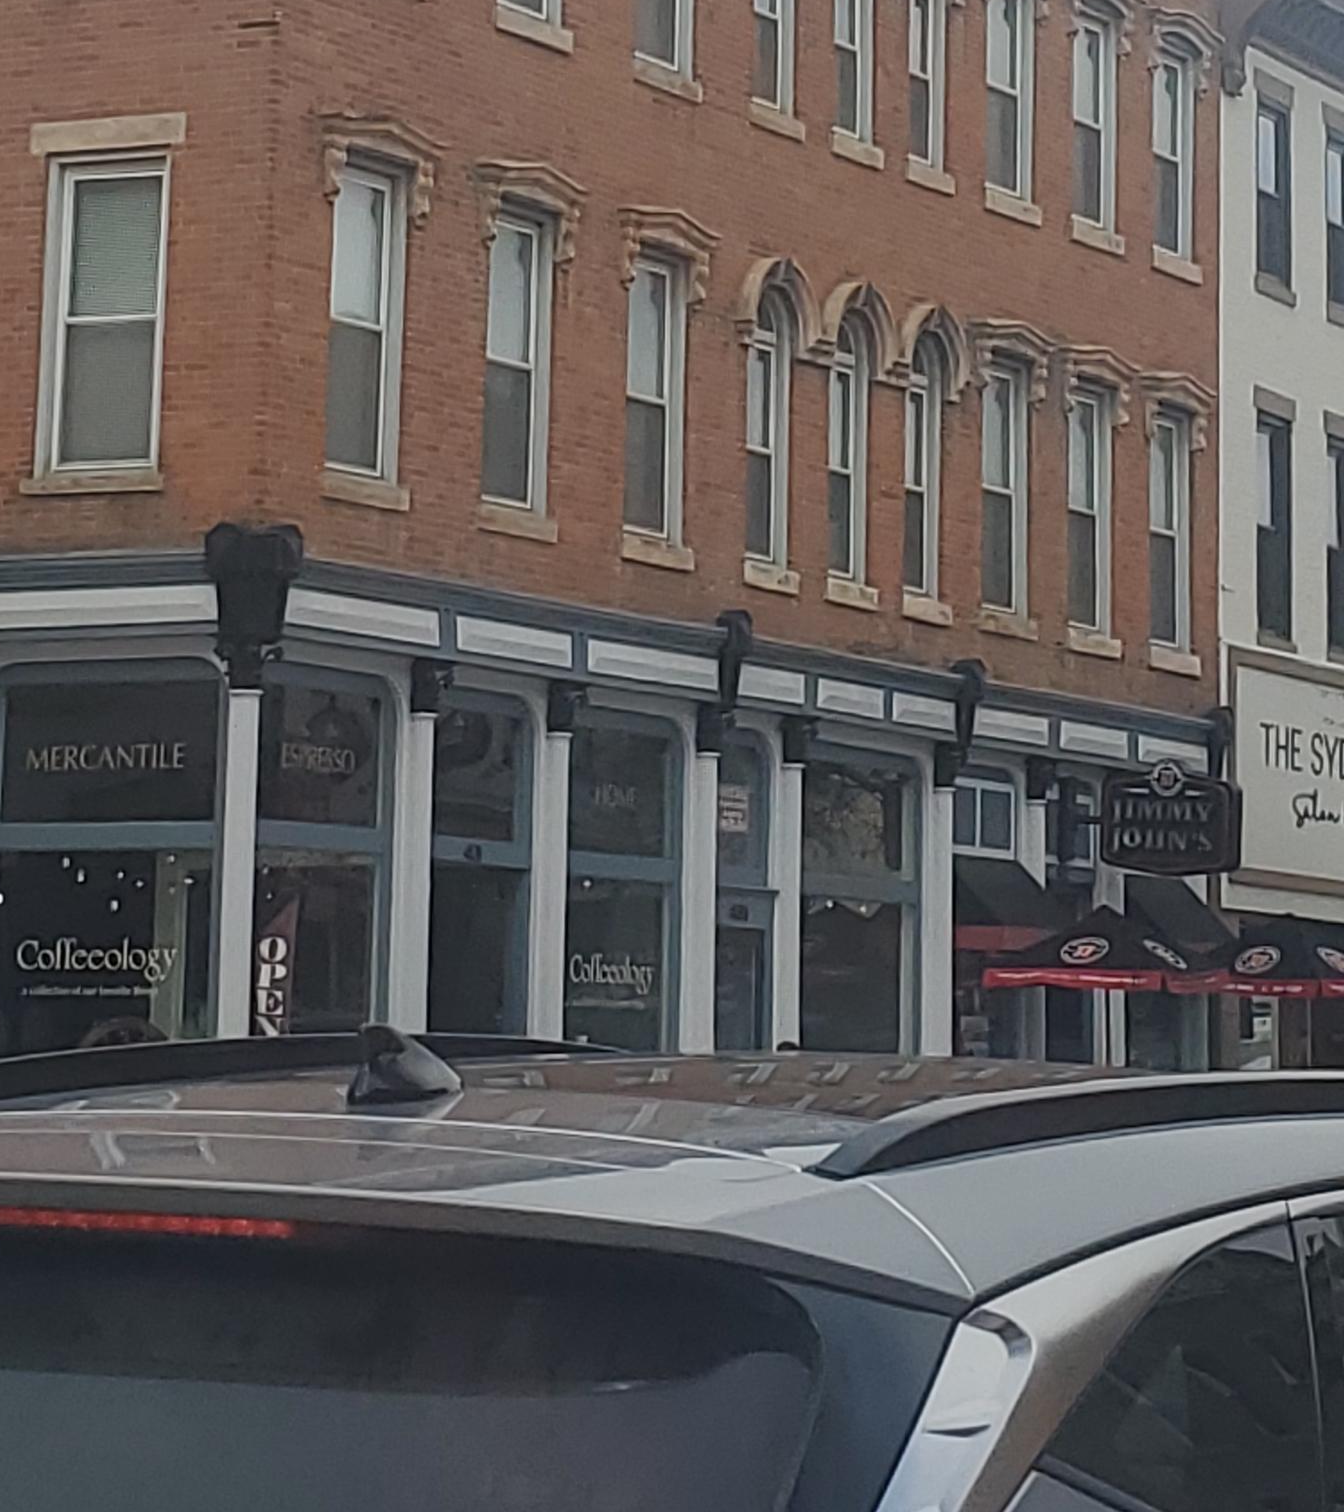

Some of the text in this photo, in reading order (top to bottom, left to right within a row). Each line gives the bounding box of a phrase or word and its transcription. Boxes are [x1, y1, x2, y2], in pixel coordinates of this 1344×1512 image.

[26, 743, 187, 772] MERCANTILE
[281, 741, 355, 774] ESPRESSO
[1260, 723, 1303, 772] THE
[1113, 799, 1213, 823] JIMMY
[1112, 827, 1213, 852] JOHN'S
[17, 937, 178, 982] Coffeeology
